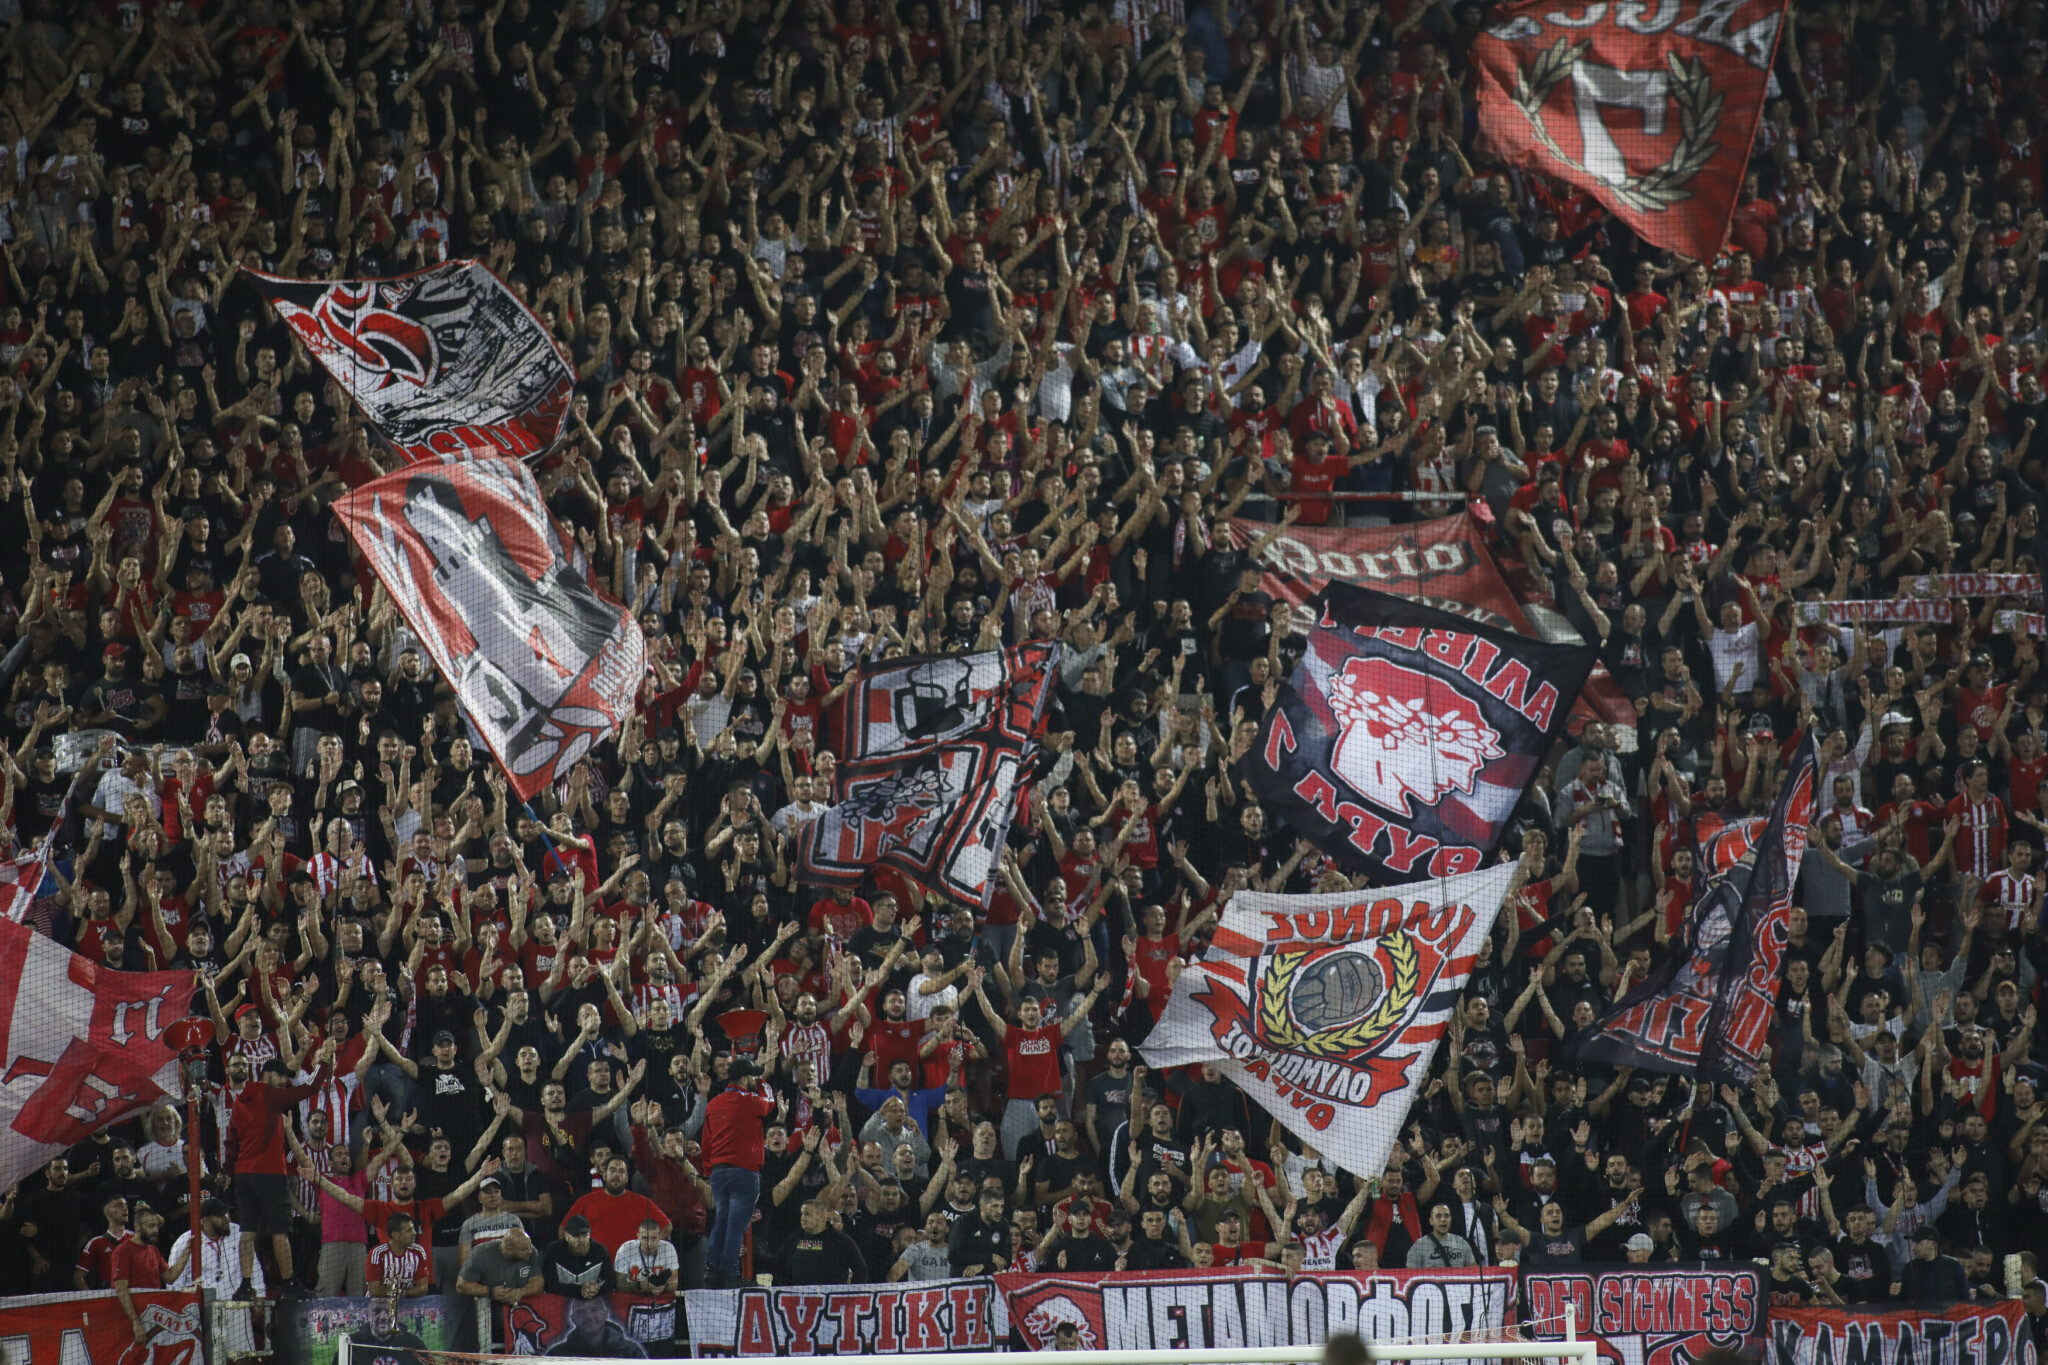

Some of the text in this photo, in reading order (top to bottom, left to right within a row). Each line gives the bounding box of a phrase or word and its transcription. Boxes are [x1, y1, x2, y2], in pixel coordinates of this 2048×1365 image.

[736, 1283, 993, 1355] ΔΥΤΙΚΗ
[1531, 1277, 1753, 1334] RED SICKNESS
